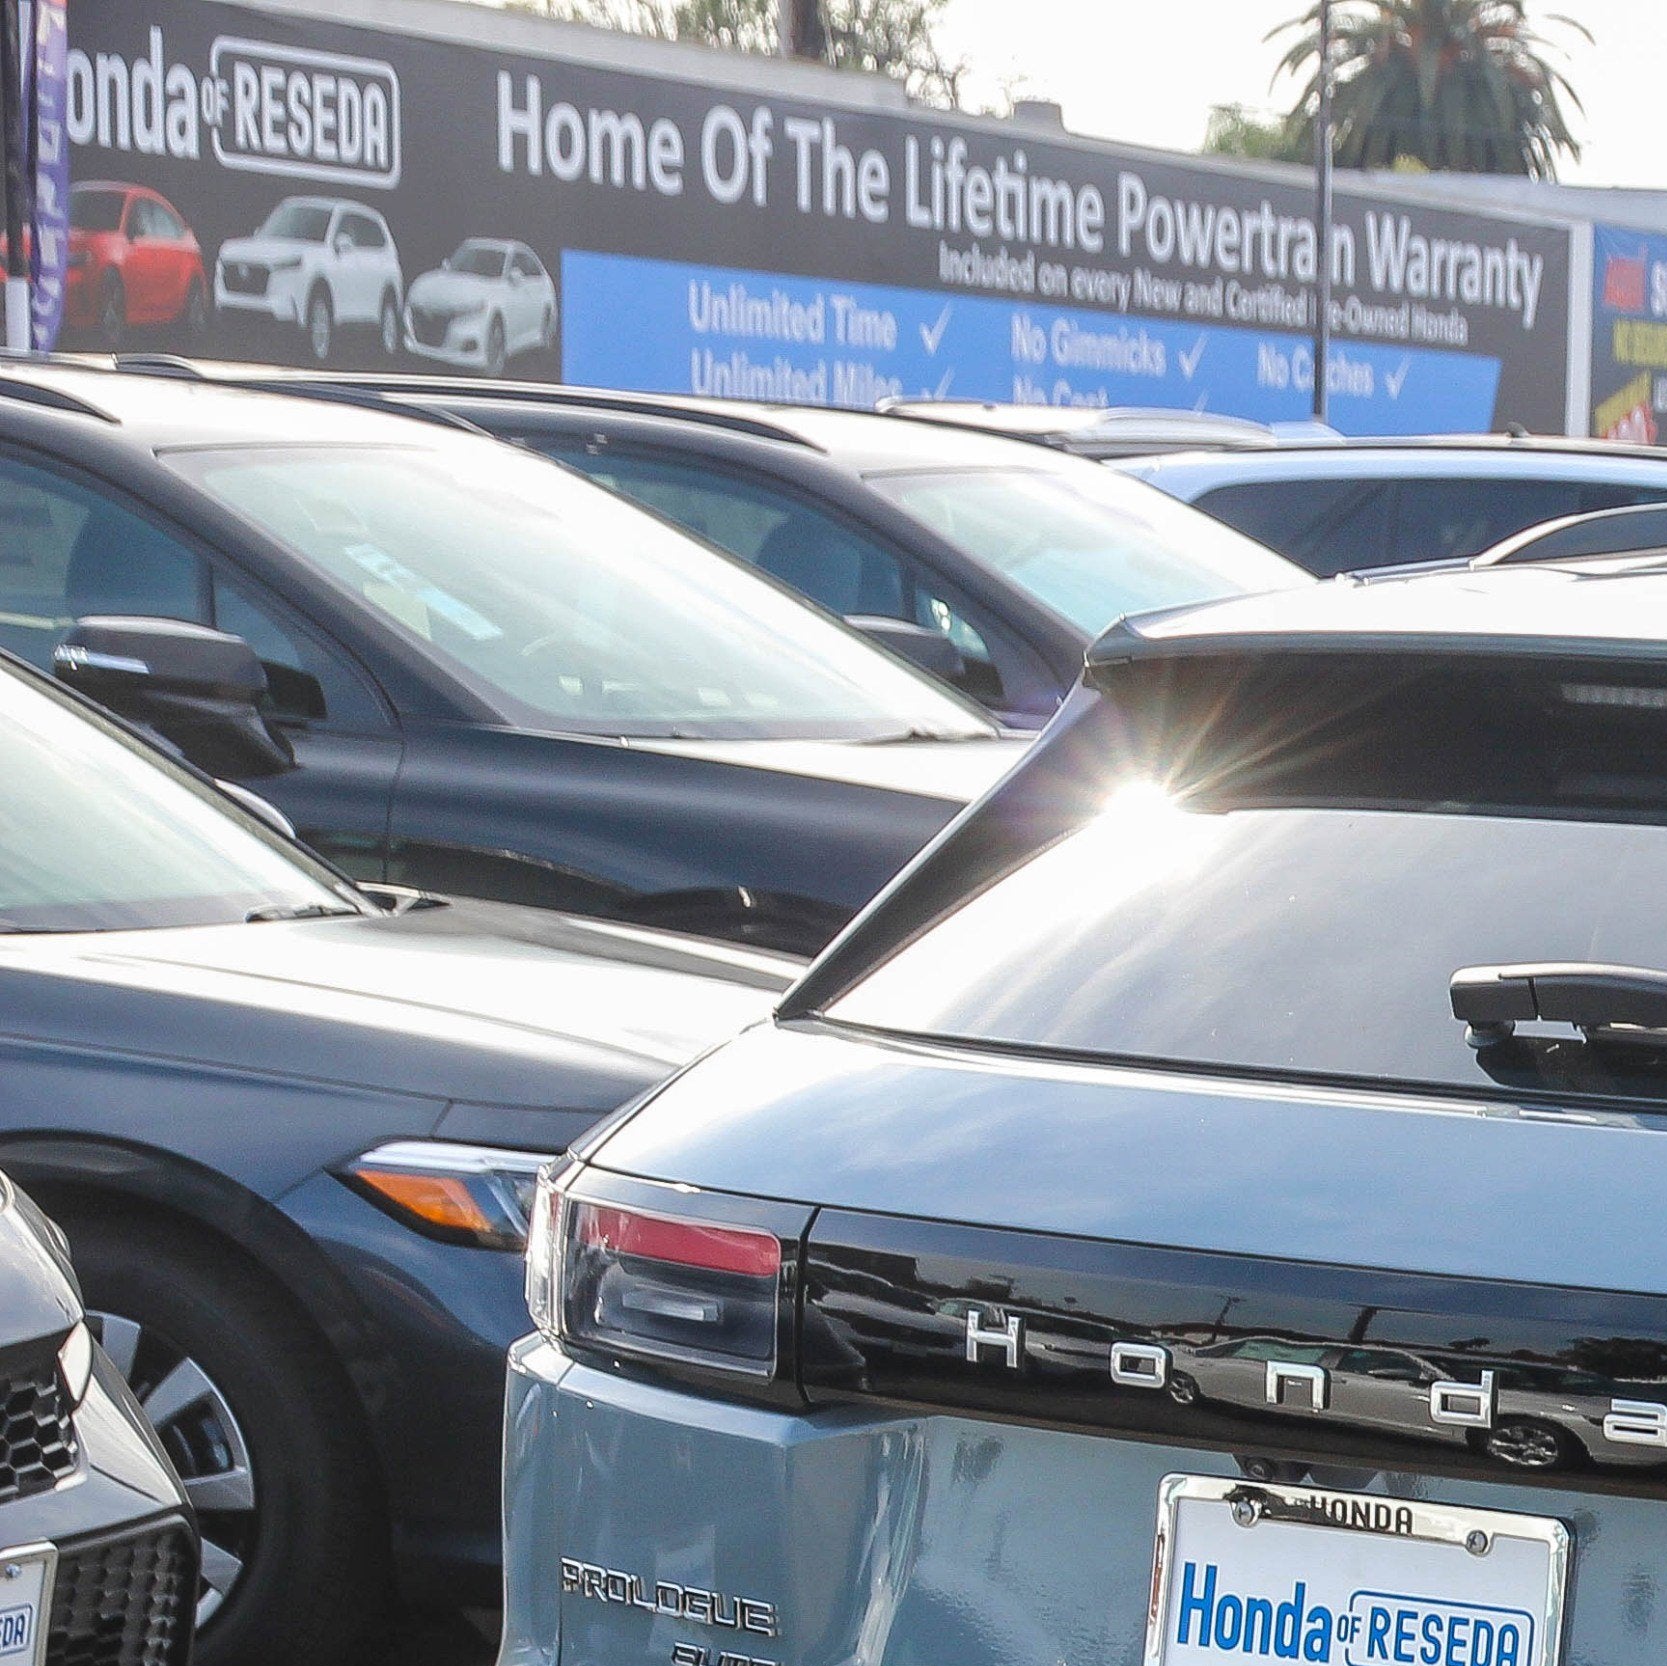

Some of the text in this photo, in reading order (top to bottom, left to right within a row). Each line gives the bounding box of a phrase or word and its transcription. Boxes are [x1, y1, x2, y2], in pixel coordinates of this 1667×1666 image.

[65, 24, 389, 169] onda OF RESEDA
[496, 69, 686, 197] Home
[702, 104, 774, 208] Of
[783, 116, 891, 224] The
[904, 133, 1105, 253] Lifetime
[1116, 170, 1356, 287] Powertran
[1364, 208, 1545, 330] Warranty
[687, 278, 898, 352] Unlimited Time
[1070, 265, 1132, 314] every
[1133, 265, 1183, 313] New
[1184, 275, 1224, 319] and
[1011, 312, 1048, 365] No
[1256, 337, 1375, 398] No Cches
[0, 1612, 26, 1649] DA
[559, 1555, 783, 1638] PROLOGUE
[1176, 1561, 1333, 1664] Honda
[1337, 1613, 1361, 1645] OF
